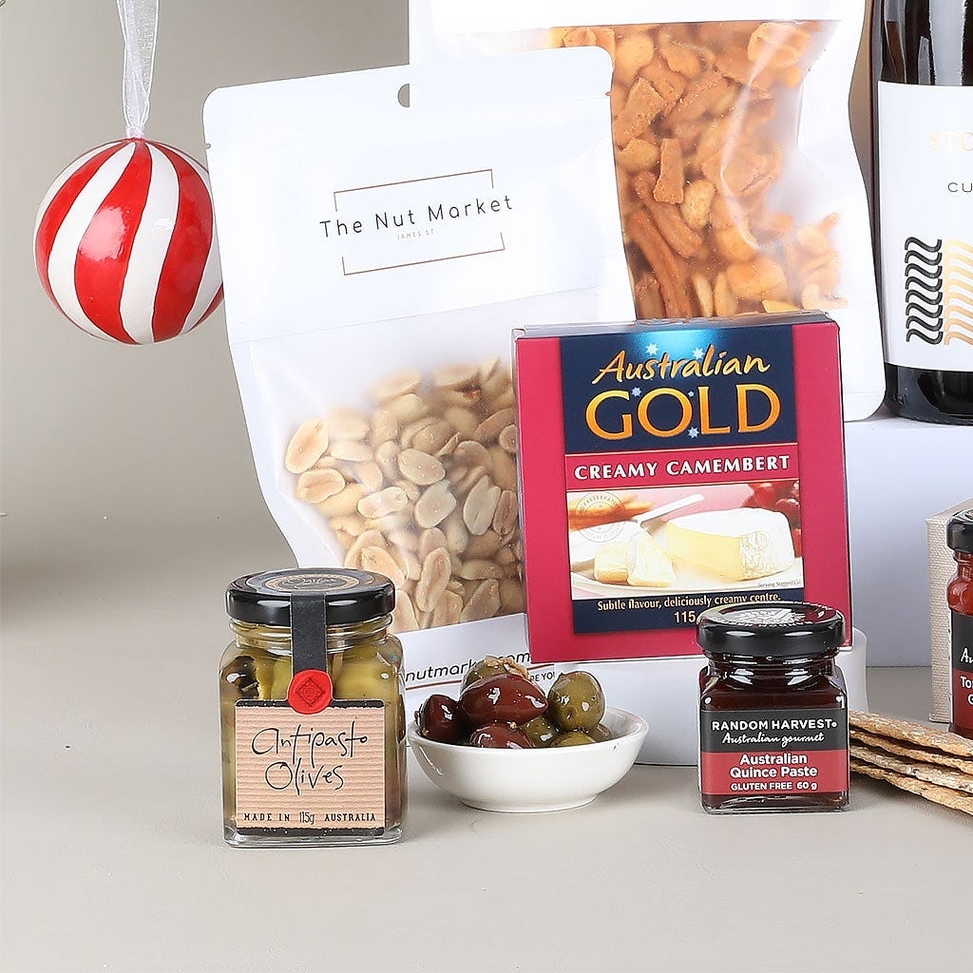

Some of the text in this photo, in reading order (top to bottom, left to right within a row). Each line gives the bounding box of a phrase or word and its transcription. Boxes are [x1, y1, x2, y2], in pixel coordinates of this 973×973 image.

[319, 195, 513, 238] The Nut Market
[591, 344, 772, 385] Australian
[585, 383, 782, 441] GOLD
[574, 455, 791, 481] CREAMY CAMEMBERT
[597, 593, 781, 611] Subtle flavour, deliciously creamy centre.
[673, 611, 697, 623] 115
[711, 720, 768, 732] RANDOM
[721, 731, 825, 748] Australian gourmet
[739, 753, 808, 766] Australian
[264, 758, 345, 796] Olives
[729, 766, 818, 779] Quince Paste
[730, 782, 768, 791] GLUTEN
[769, 782, 793, 790] FREE
[244, 811, 377, 825] MADE IN 115g AUSTRALIA
